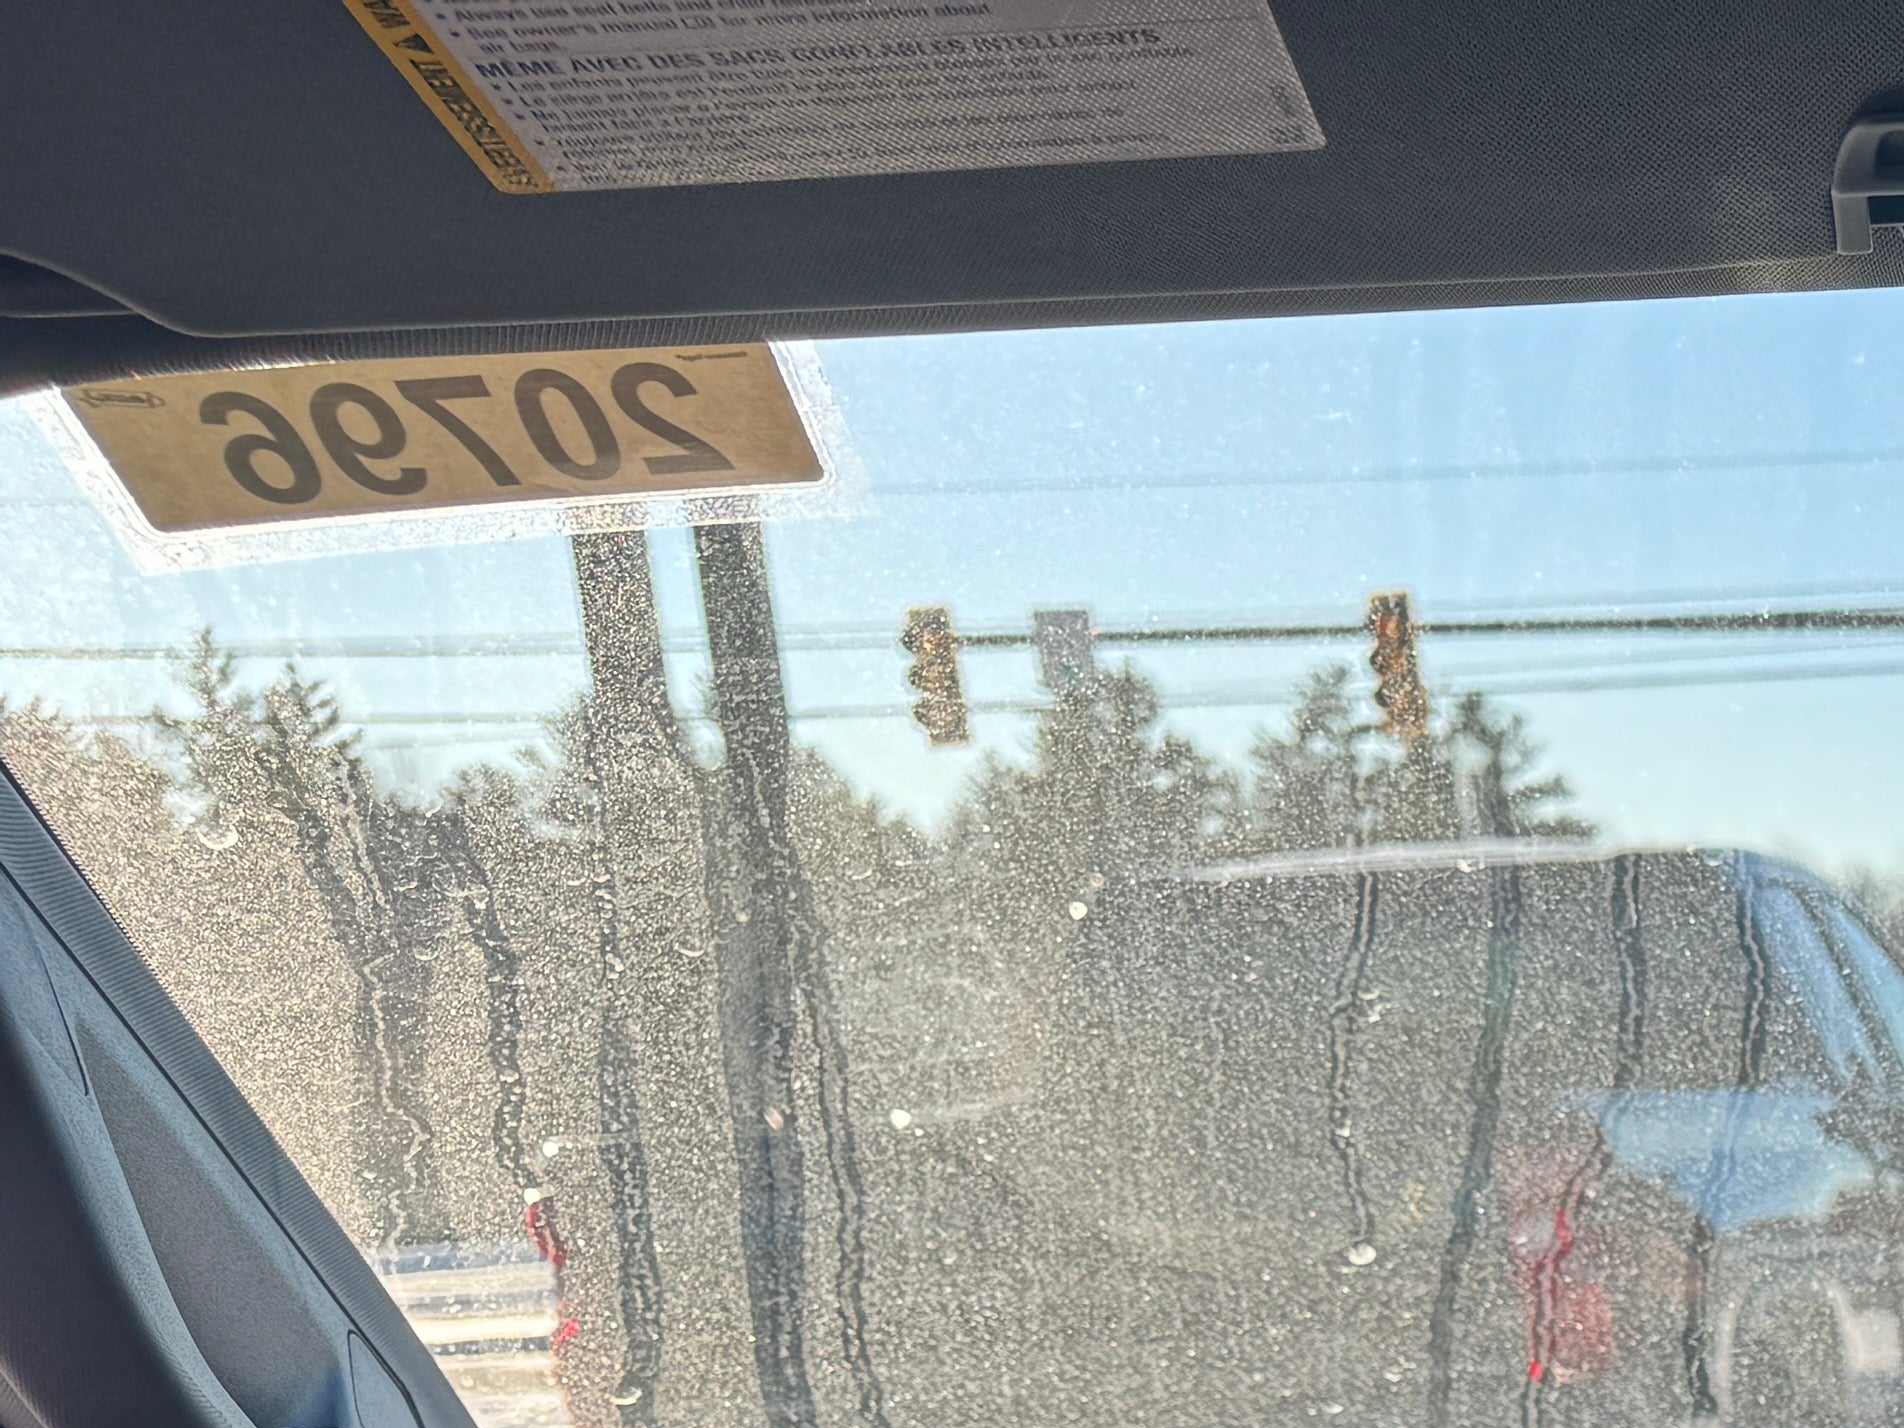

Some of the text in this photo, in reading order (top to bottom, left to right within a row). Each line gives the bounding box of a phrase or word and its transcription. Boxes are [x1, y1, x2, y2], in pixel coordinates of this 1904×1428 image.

[474, 56, 567, 78] MÊME
[571, 54, 643, 74] AVEC
[647, 52, 705, 72] DES
